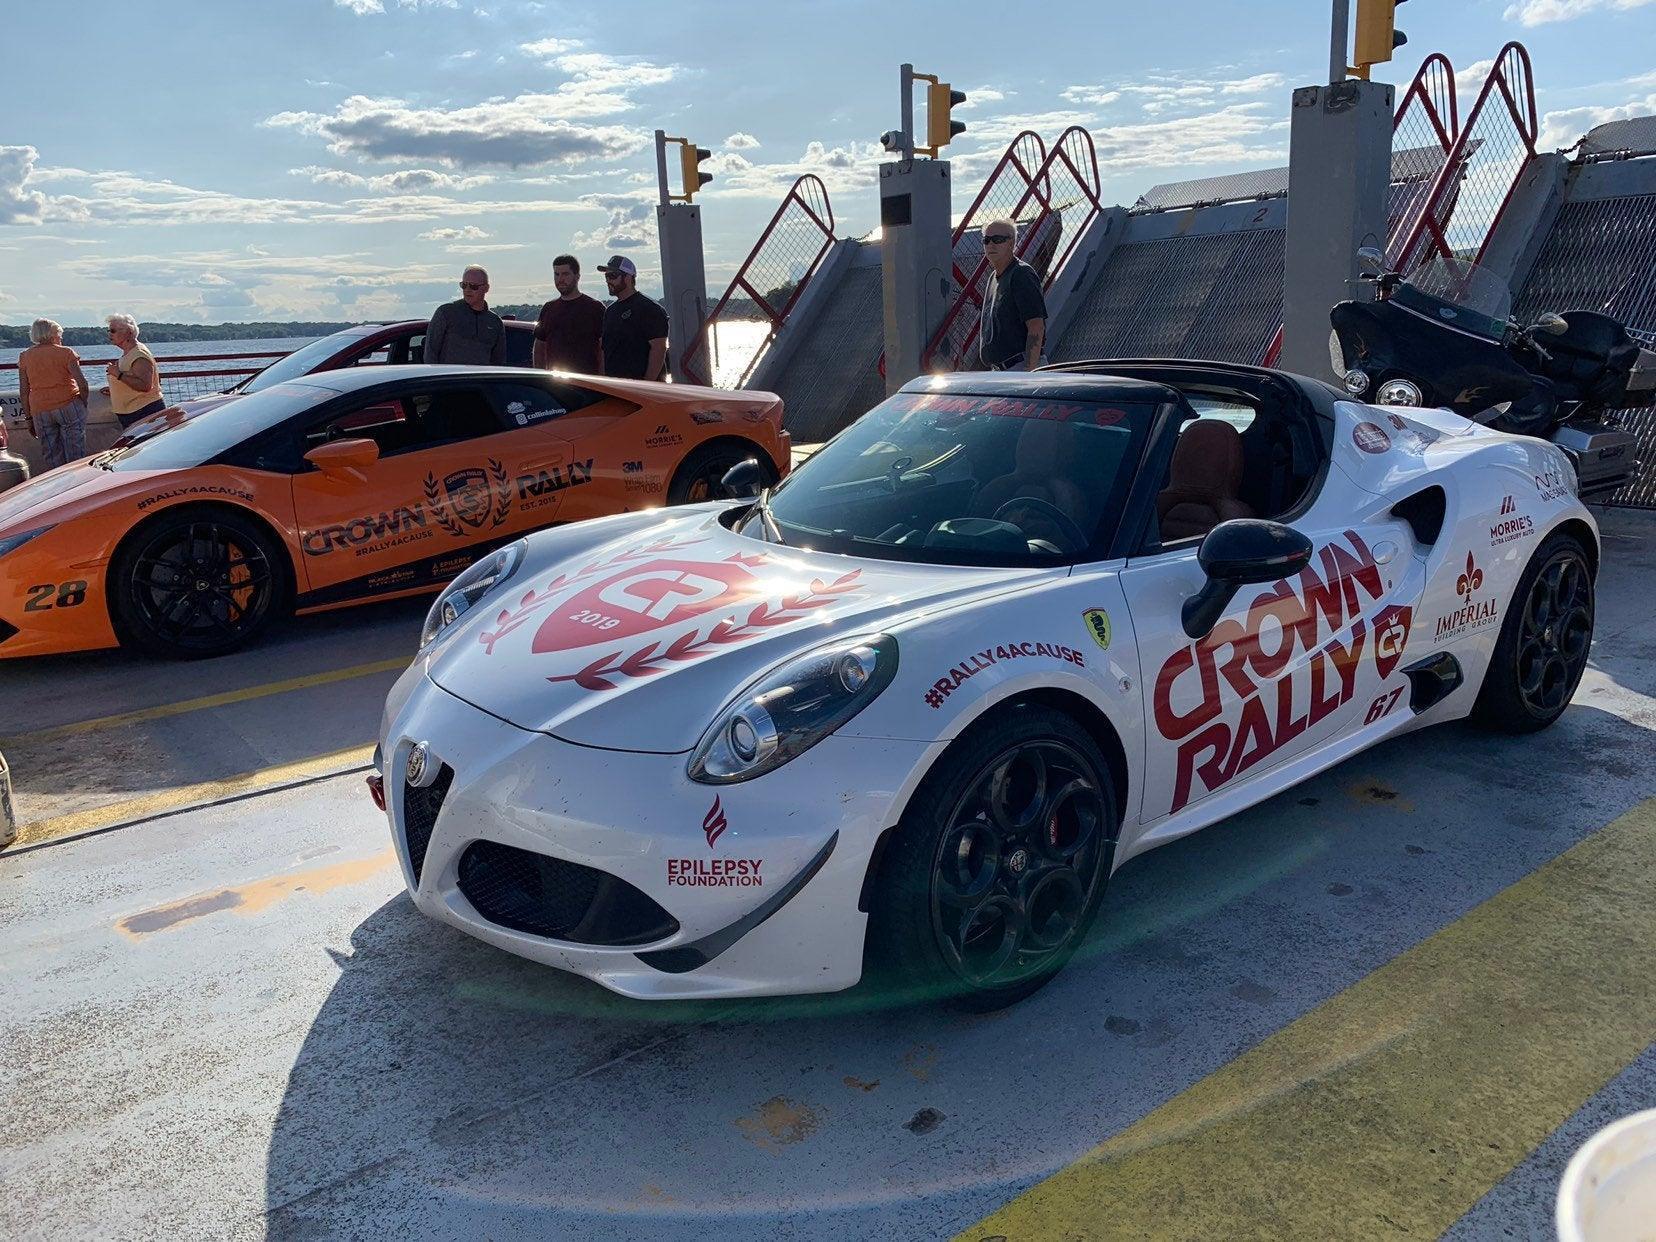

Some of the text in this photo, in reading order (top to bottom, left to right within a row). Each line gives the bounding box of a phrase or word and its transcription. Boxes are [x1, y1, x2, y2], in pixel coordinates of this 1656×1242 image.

[1253, 207, 1269, 223] 2
[515, 458, 594, 500] RALLY
[622, 461, 643, 473] 3M
[137, 485, 255, 510] #RALLY4ACAUSE
[303, 502, 427, 557] CROWN
[1489, 515, 1533, 539] MORRIE'S
[355, 530, 434, 557] #RALLY4ACAUSE
[24, 580, 88, 612] 28
[569, 610, 620, 630] 2019
[1435, 598, 1498, 637] IMPERIAL
[1153, 529, 1384, 741] CROWN
[924, 642, 1085, 710] #RALLY4ACAUSE
[1169, 617, 1367, 816] RALLY
[1363, 685, 1406, 726] 67
[667, 859, 763, 876] EPILEPSY
[668, 875, 763, 887] FOUNDATION
